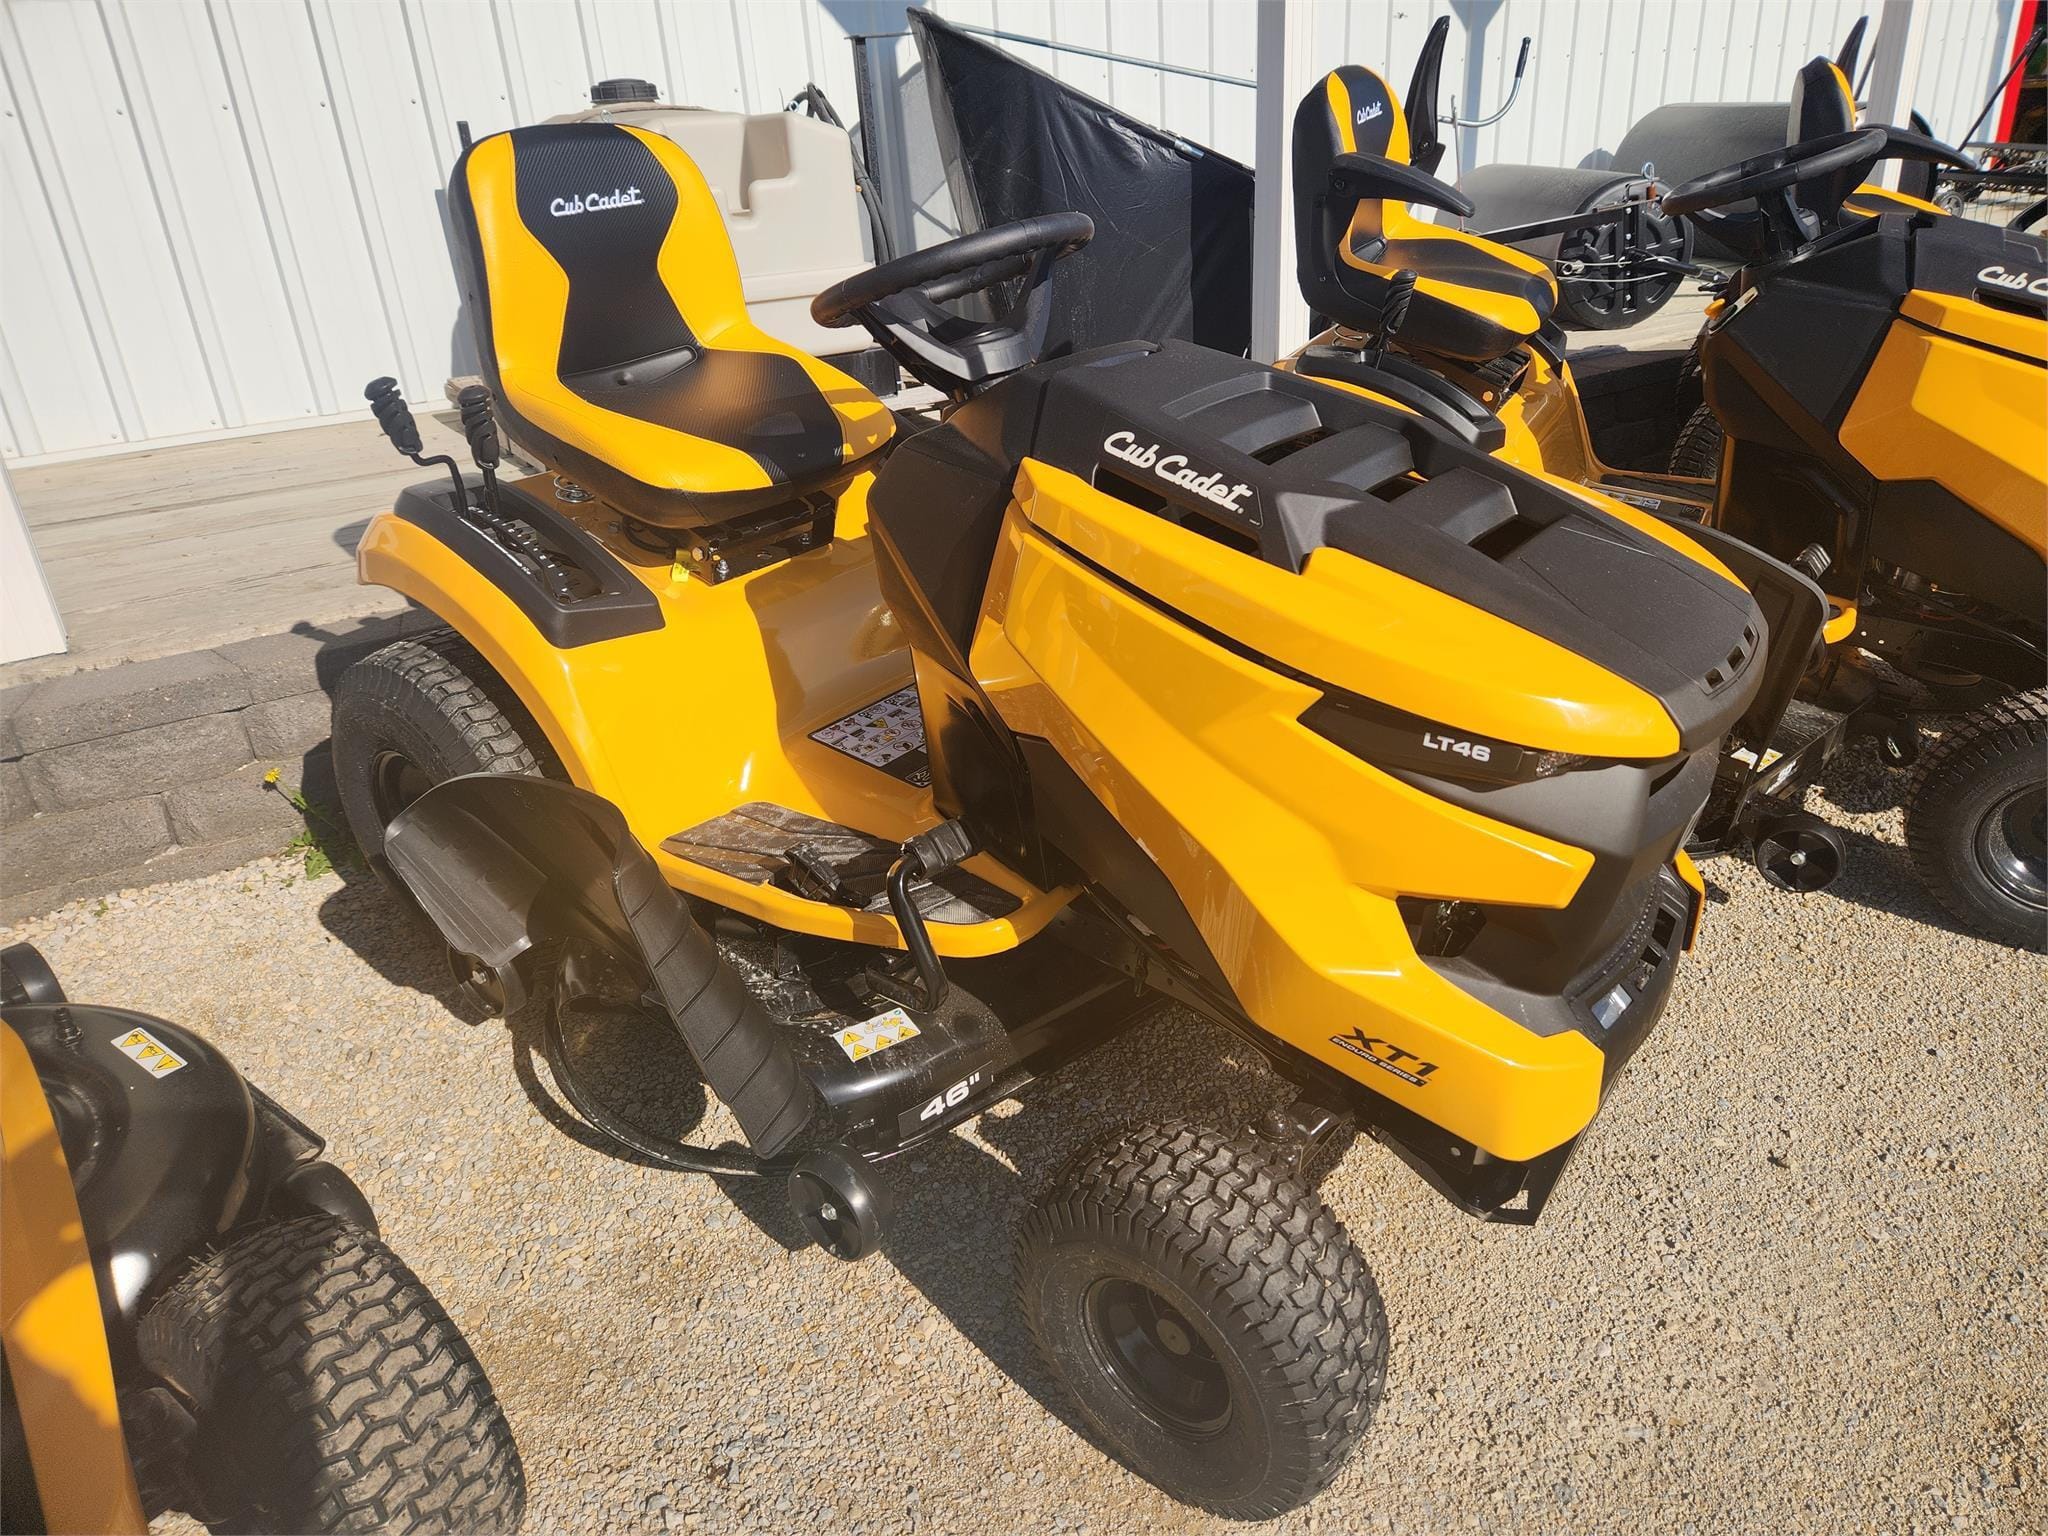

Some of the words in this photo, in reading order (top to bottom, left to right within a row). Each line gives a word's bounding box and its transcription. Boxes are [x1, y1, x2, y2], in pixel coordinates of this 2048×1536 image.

[550, 194, 584, 217] Cub
[585, 186, 642, 212] Cadet
[1977, 266, 2030, 290] Cub
[1103, 431, 1160, 469] Cub
[1154, 454, 1253, 512] Cadet
[1422, 732, 1491, 762] LT46
[1331, 1036, 1378, 1063] ENDURO
[1379, 1060, 1418, 1084] SERIES
[1336, 1026, 1440, 1077] XT1
[920, 1071, 980, 1121] 46"
